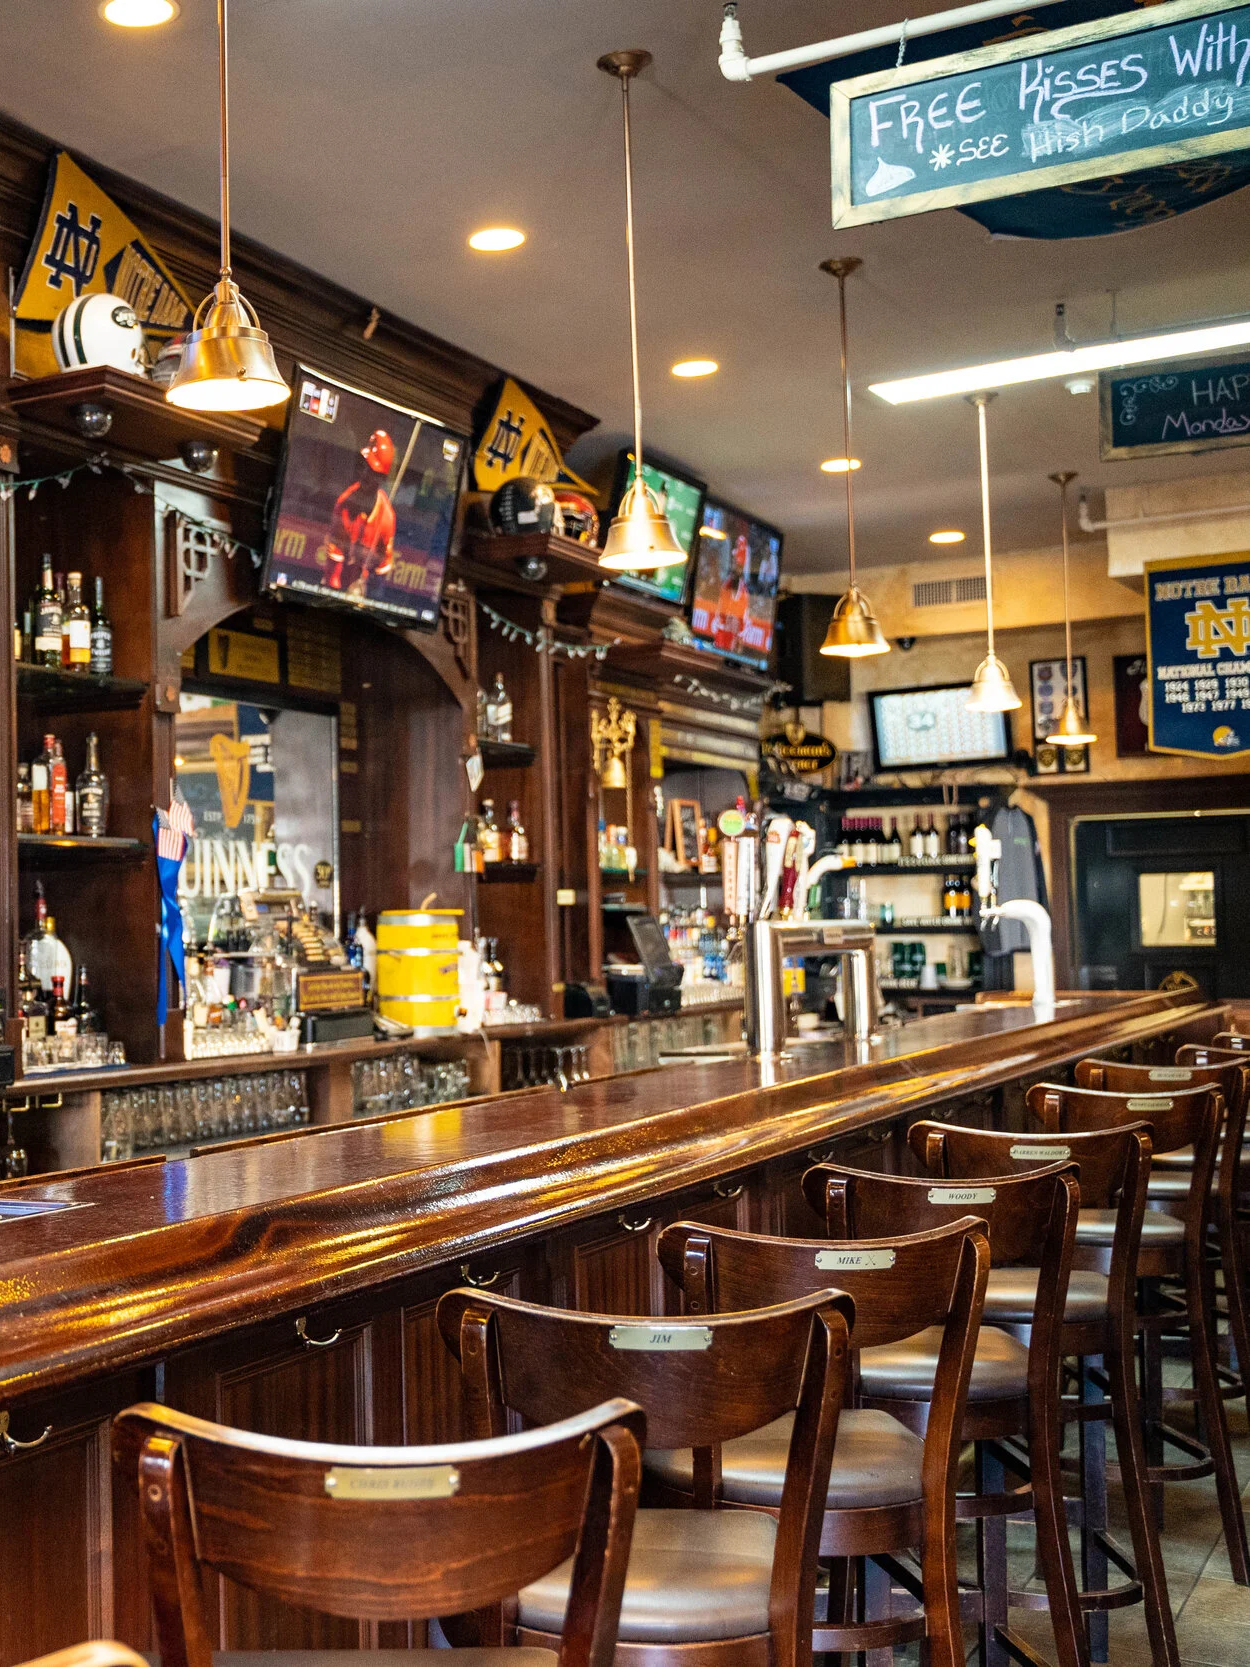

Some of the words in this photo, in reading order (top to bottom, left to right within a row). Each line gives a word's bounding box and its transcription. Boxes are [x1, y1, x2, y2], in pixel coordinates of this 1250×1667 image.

[868, 82, 986, 153] FREE
[1169, 22, 1250, 87] With
[956, 134, 1009, 165] SEE
[1122, 88, 1234, 134] Daddy
[1192, 374, 1250, 405] HAP
[1155, 577, 1220, 601] NOTRE
[1223, 574, 1250, 595] DA
[1157, 662, 1215, 680] NATIONAL
[1165, 681, 1189, 693] 1924
[1194, 678, 1219, 690] 1929
[1225, 676, 1249, 689] 1930
[1195, 690, 1219, 701] 1947
[1211, 699, 1236, 711] 1977
[179, 839, 310, 900] UINNESS
[837, 1257, 862, 1265] MIKE
[650, 1334, 672, 1344] JIM
